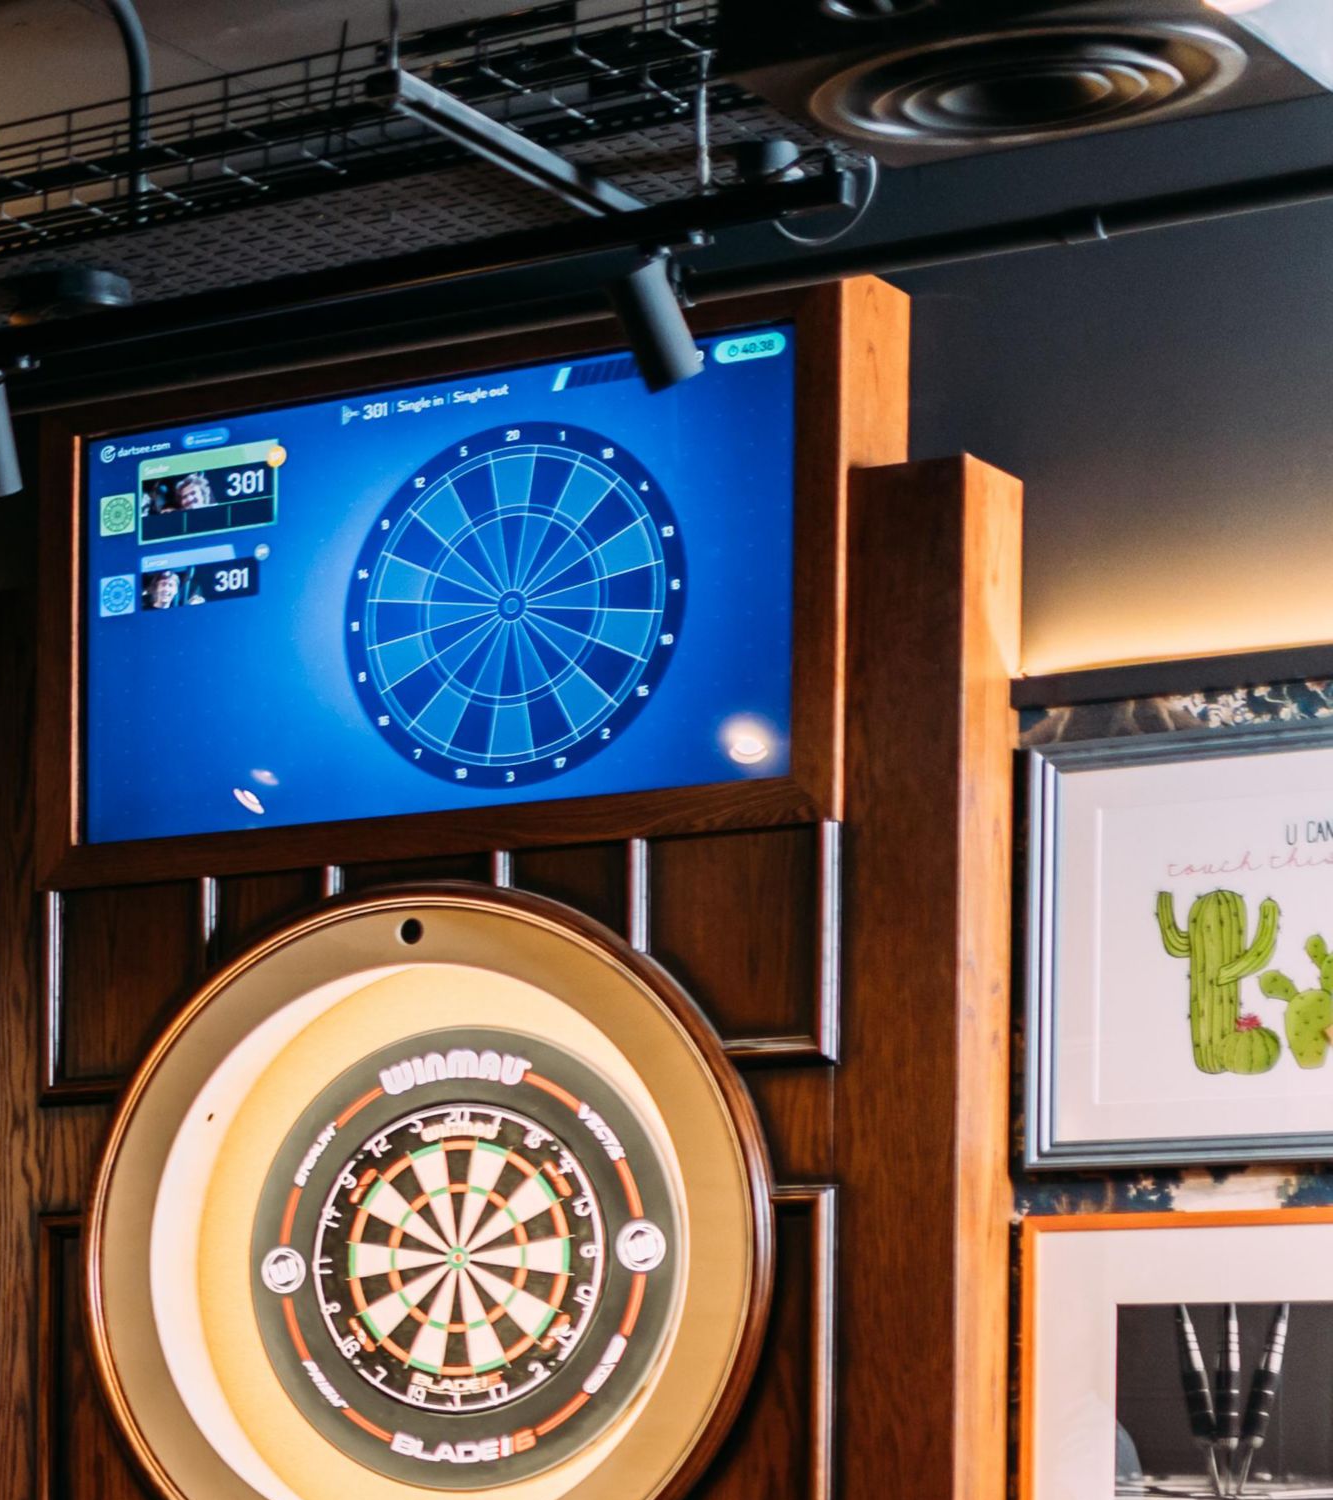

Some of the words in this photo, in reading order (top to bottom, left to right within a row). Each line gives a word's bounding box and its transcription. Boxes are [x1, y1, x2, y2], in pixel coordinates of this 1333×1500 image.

[362, 402, 389, 420] 301
[397, 397, 431, 412] Single
[433, 395, 444, 407] in
[453, 388, 487, 403] Single
[489, 384, 509, 398] out
[505, 429, 520, 442] 20
[559, 431, 566, 441] 1
[117, 442, 171, 458] dartsee.com
[459, 446, 468, 457] 5
[601, 447, 615, 459] 18
[227, 468, 265, 496] 301
[214, 568, 249, 592] 301
[1285, 823, 1298, 846] U
[1166, 850, 1263, 877] touch
[379, 1049, 531, 1095] WINMAU
